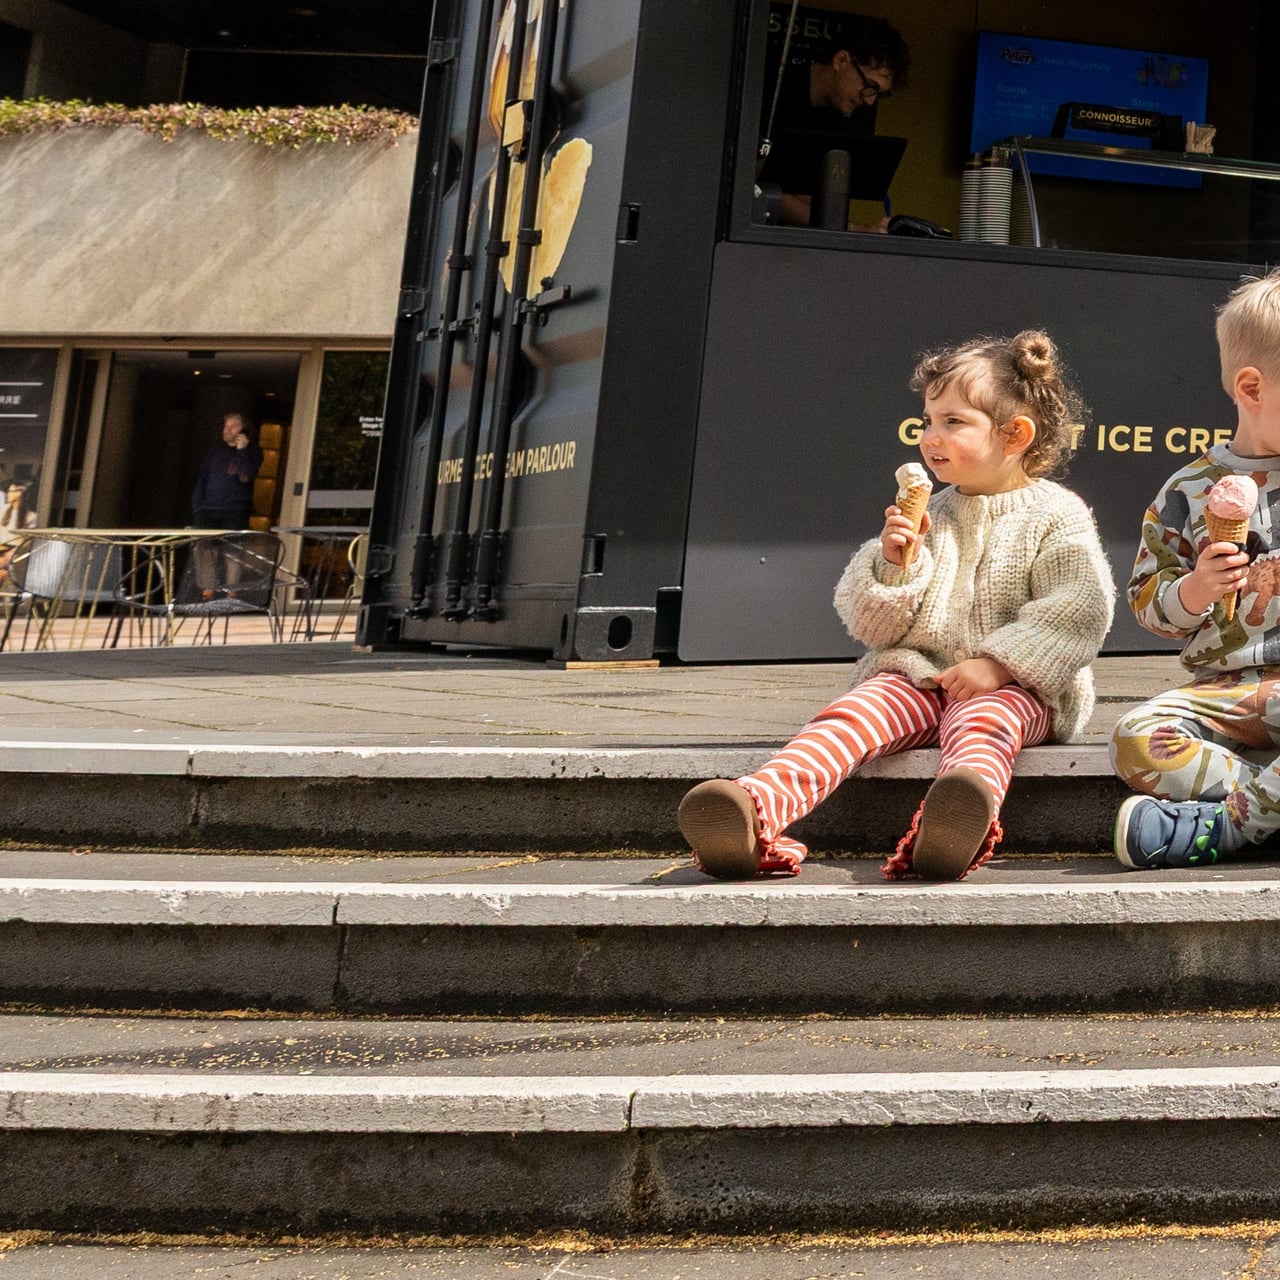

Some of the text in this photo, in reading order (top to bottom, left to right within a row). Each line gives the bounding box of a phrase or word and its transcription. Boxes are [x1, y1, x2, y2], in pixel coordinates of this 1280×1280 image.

[1079, 109, 1153, 127] CONNOISSEUR
[1097, 424, 1154, 453] ICE
[1165, 426, 1233, 454] CRE
[525, 440, 577, 476] PARLOUR
